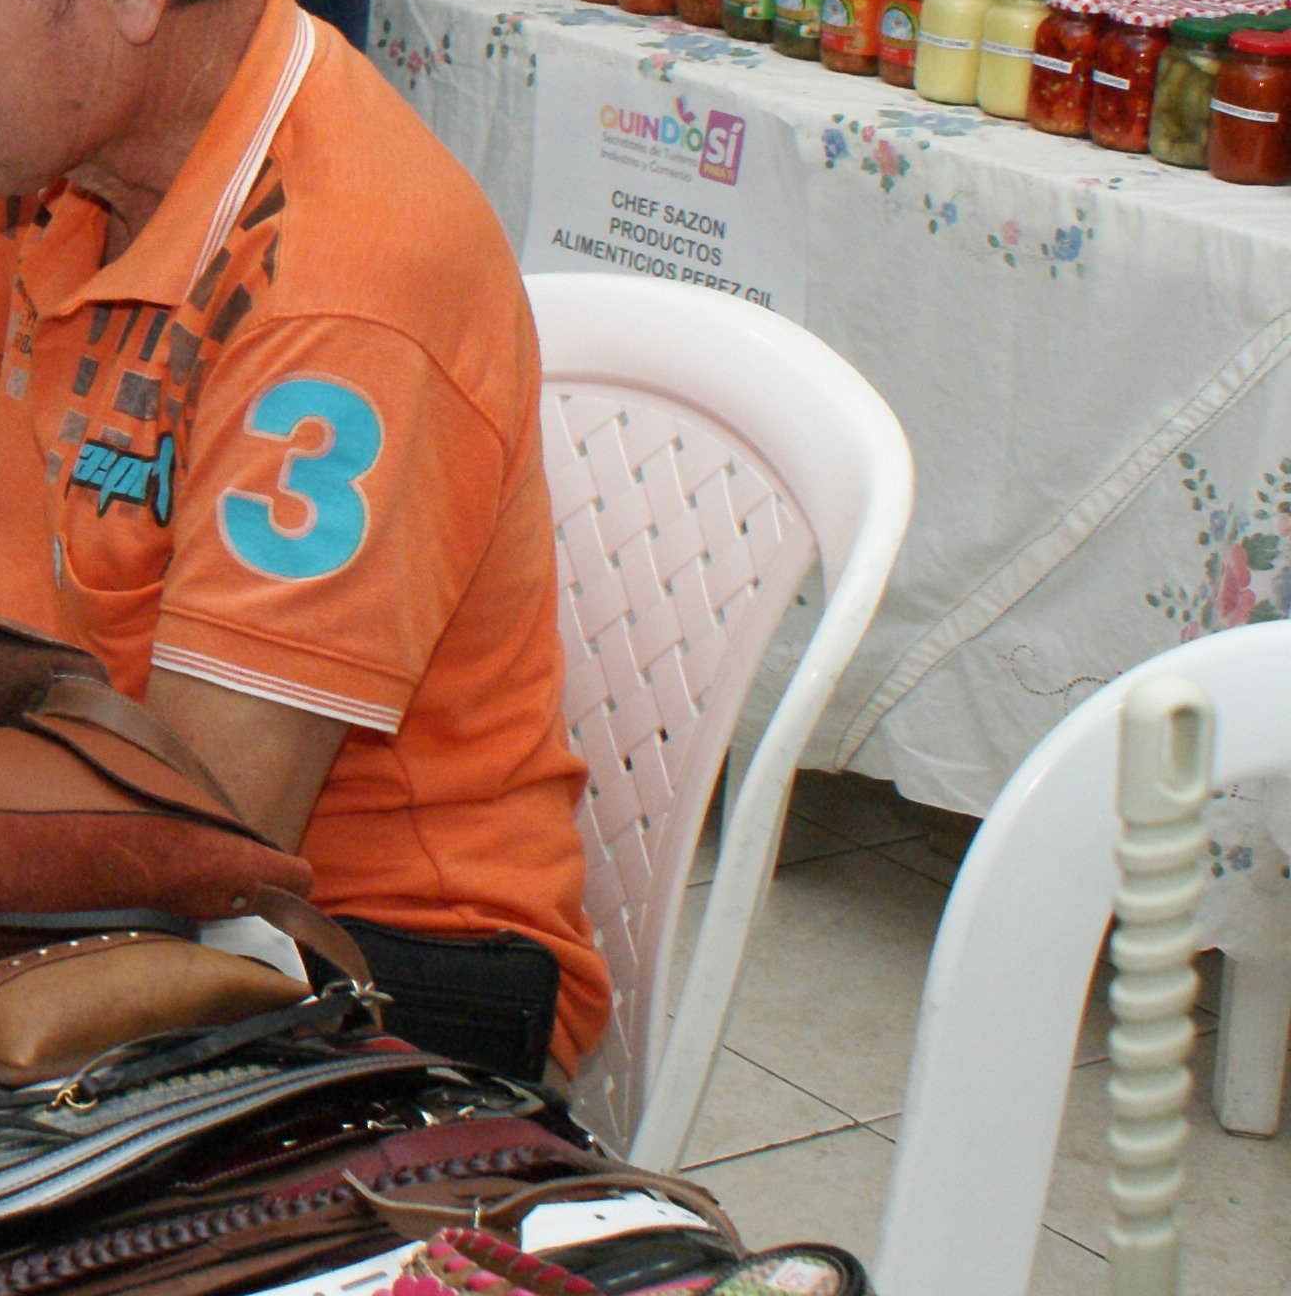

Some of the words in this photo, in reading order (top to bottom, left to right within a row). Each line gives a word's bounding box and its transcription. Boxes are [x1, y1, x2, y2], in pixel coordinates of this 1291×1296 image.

[610, 216, 723, 266] PRODUCTOS
[611, 189, 660, 218] CHEF
[663, 204, 726, 240] SAZON
[551, 228, 677, 281] ALIMENTICIOS
[681, 265, 741, 298] PEREZ
[218, 370, 386, 582] 3
